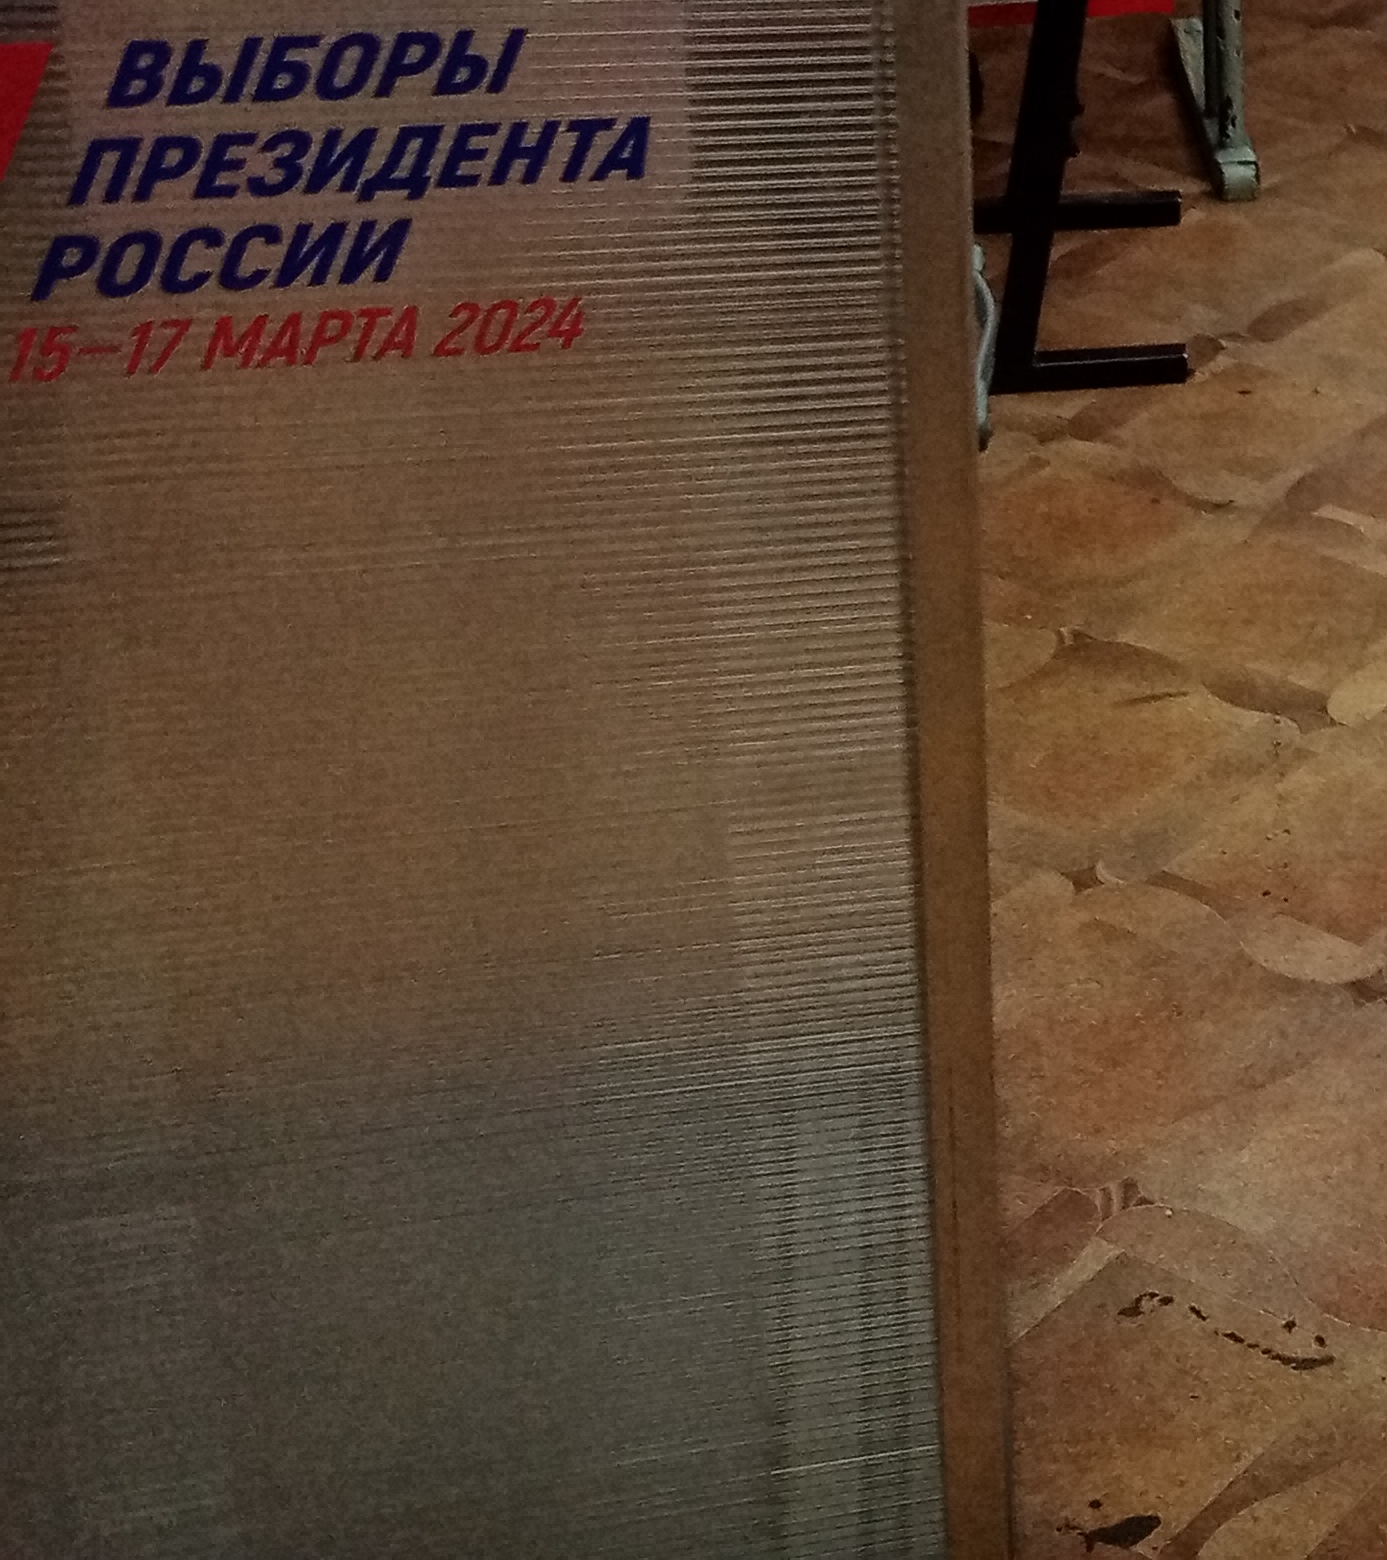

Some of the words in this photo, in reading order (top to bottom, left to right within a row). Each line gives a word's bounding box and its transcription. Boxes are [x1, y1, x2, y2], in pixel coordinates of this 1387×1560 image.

[105, 28, 528, 111] ВЫБОРЫ
[66, 116, 651, 205] ПРЕЗИДЕНТА
[30, 219, 412, 303] РОССИИ
[202, 304, 419, 372] МАРТА
[433, 296, 586, 358] 2024
